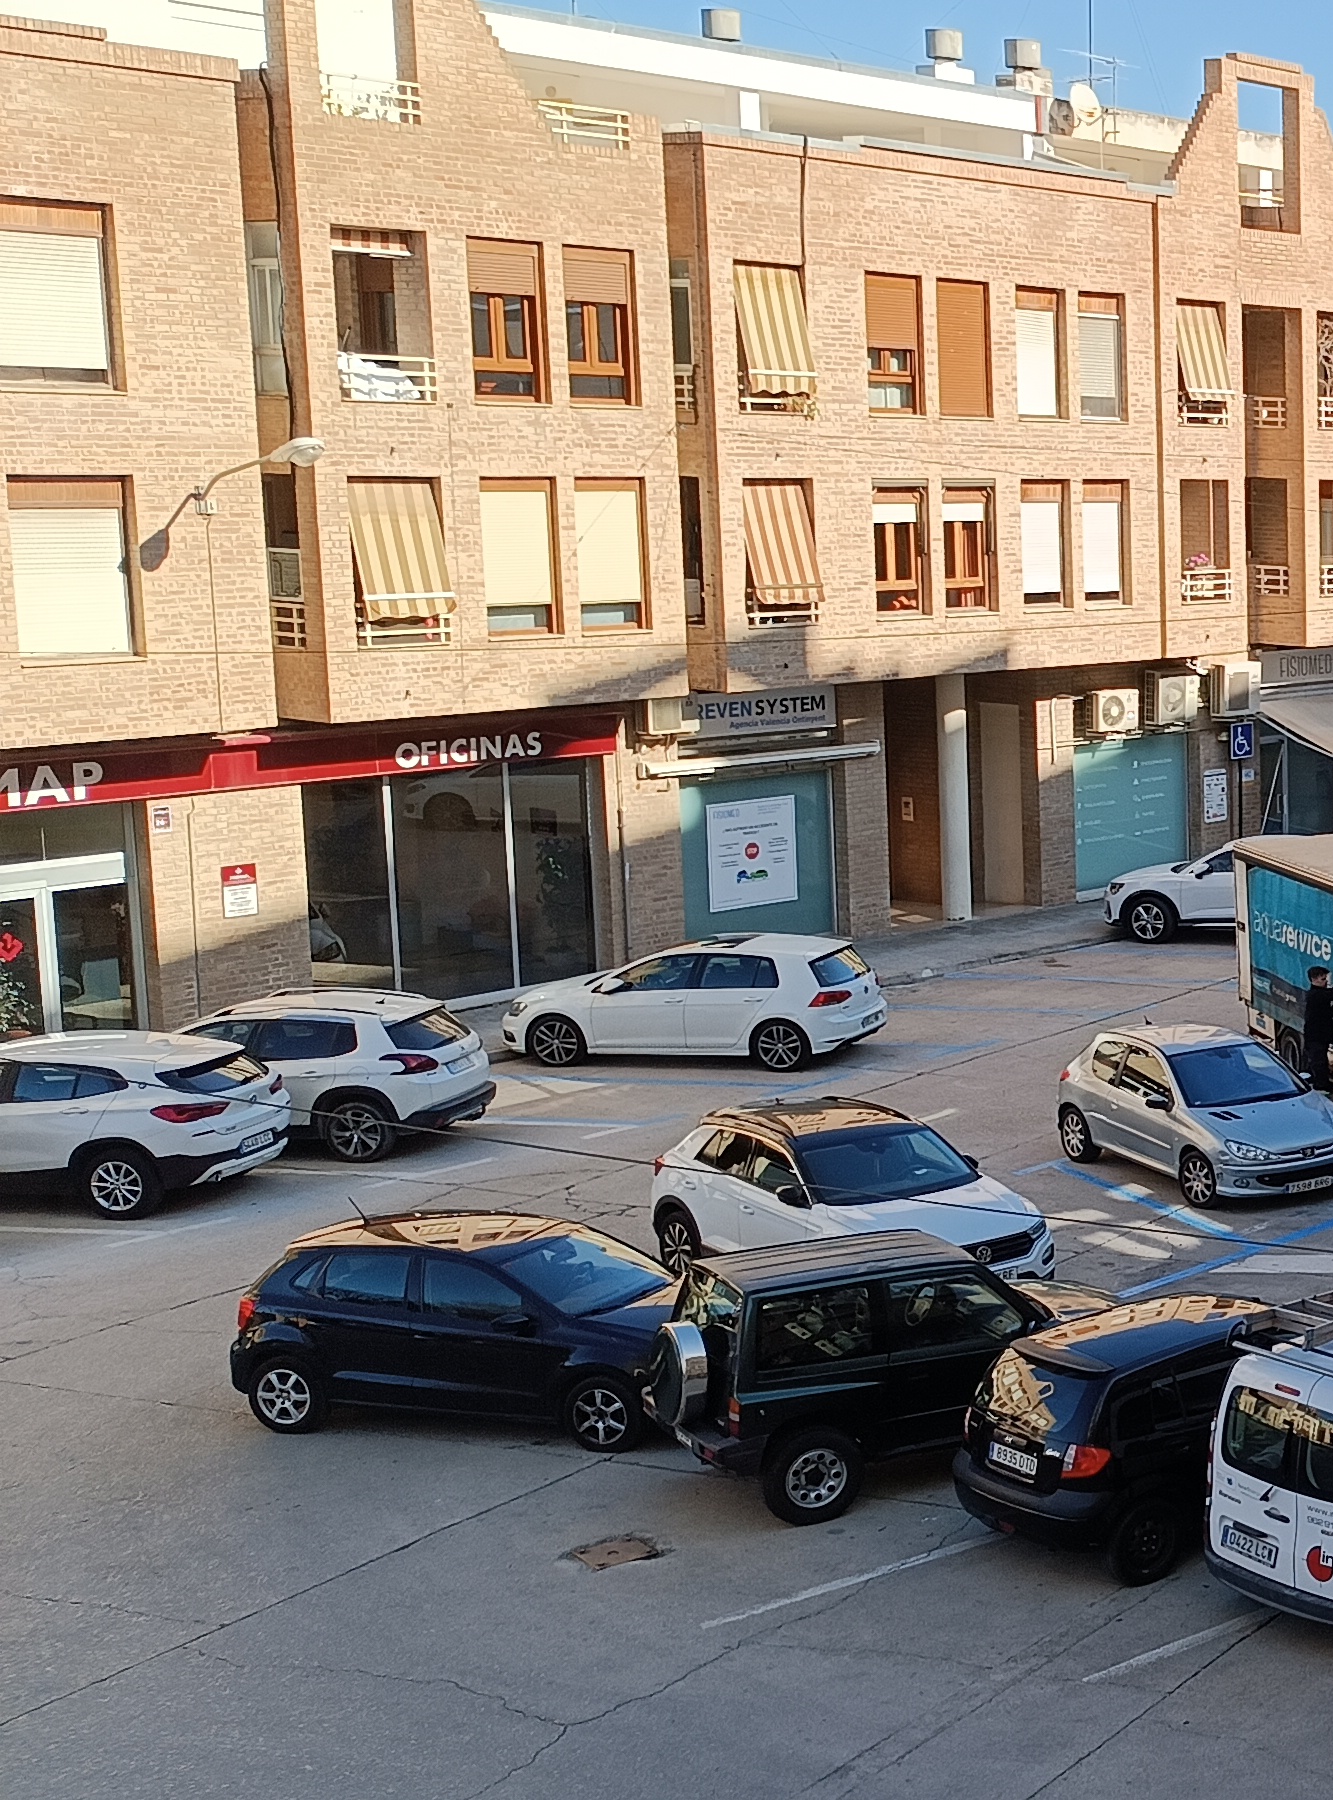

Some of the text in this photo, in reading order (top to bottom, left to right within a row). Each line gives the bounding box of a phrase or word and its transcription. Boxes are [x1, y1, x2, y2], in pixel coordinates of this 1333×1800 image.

[1280, 654, 1332, 677] FISIOMED
[729, 718, 758, 729] Agencia
[760, 717, 790, 726] Valencia
[395, 731, 542, 769] OFICINAS
[1253, 910, 1332, 961] aquaservice
[1290, 1181, 1312, 1193] 7598
[996, 1446, 1018, 1466] 8935
[1229, 1531, 1253, 1555] 0422
